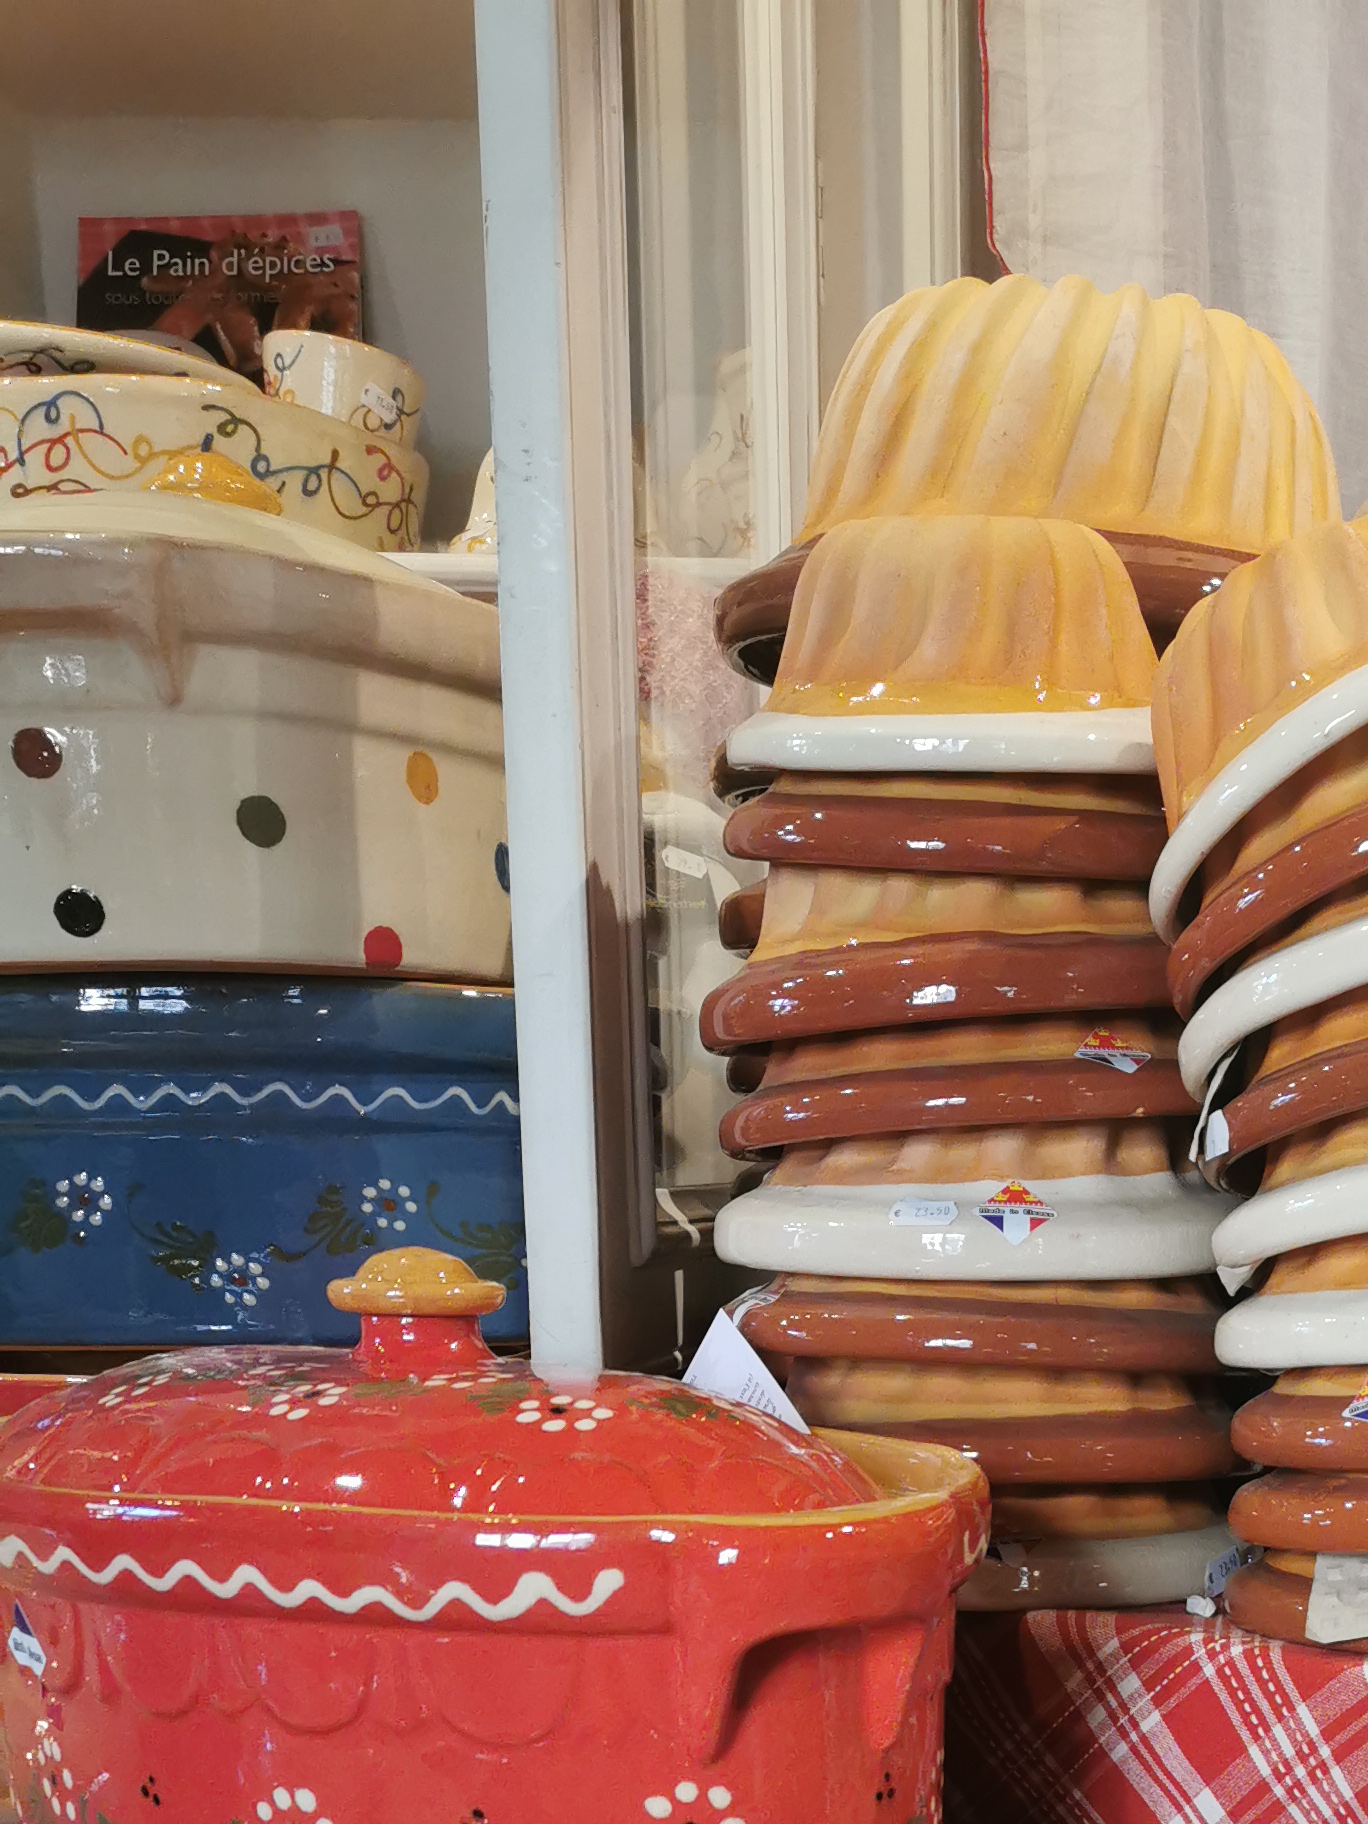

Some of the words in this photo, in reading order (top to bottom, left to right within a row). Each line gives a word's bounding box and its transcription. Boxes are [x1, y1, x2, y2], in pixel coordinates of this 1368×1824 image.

[106, 250, 141, 277] Le
[152, 249, 210, 277] Pain
[221, 248, 336, 284] d'épices
[914, 1205, 950, 1218] 23.50
